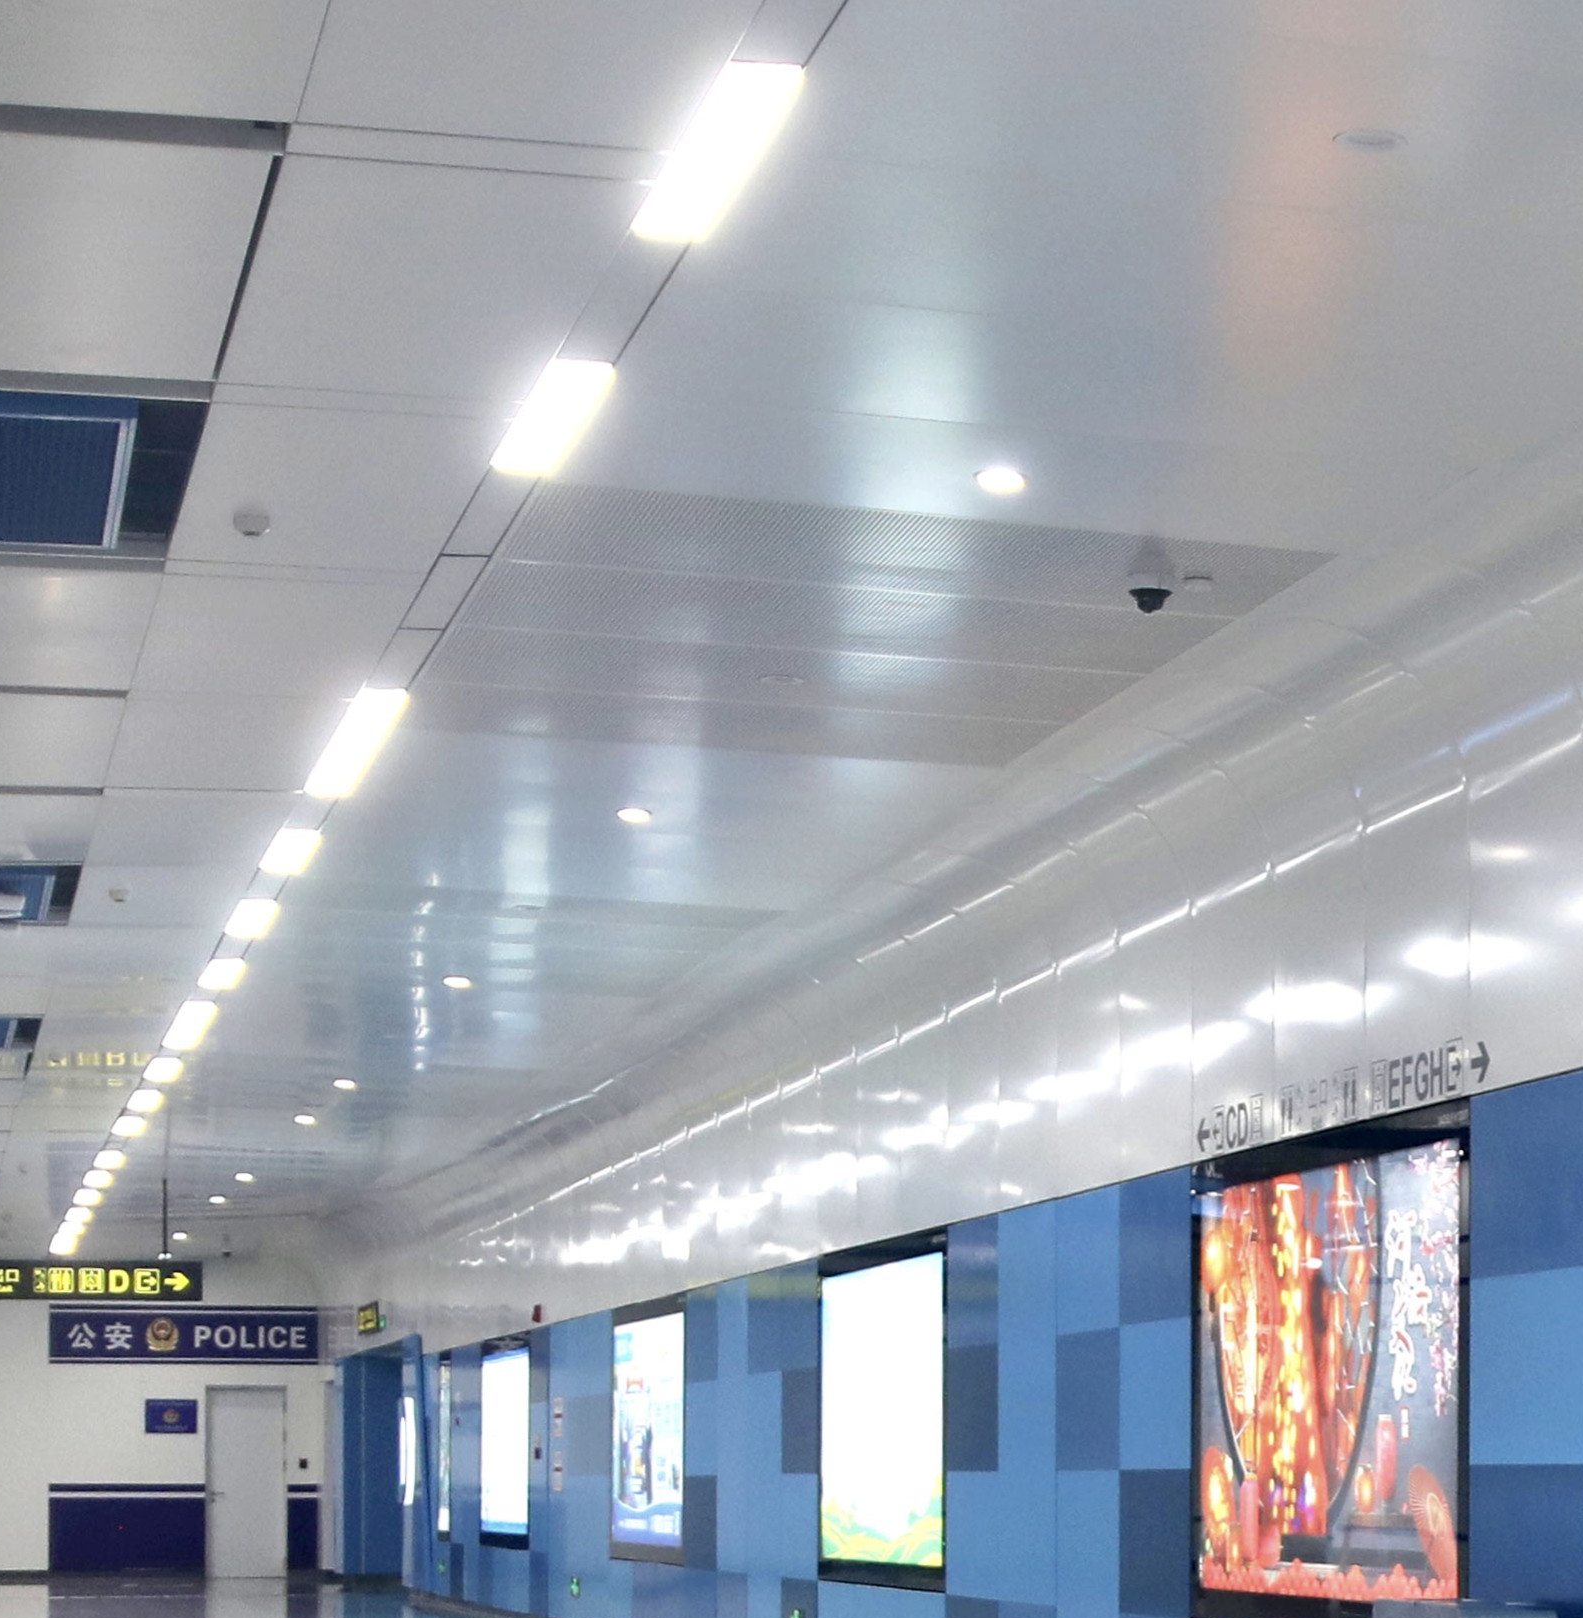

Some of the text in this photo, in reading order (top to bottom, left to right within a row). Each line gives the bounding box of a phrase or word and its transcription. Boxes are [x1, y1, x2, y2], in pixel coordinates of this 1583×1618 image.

[1388, 1046, 1443, 1109] EFGH
[1226, 1102, 1249, 1149] CD
[108, 1270, 130, 1292] D
[68, 1322, 134, 1349] 公安
[193, 1325, 307, 1349] POLICE
